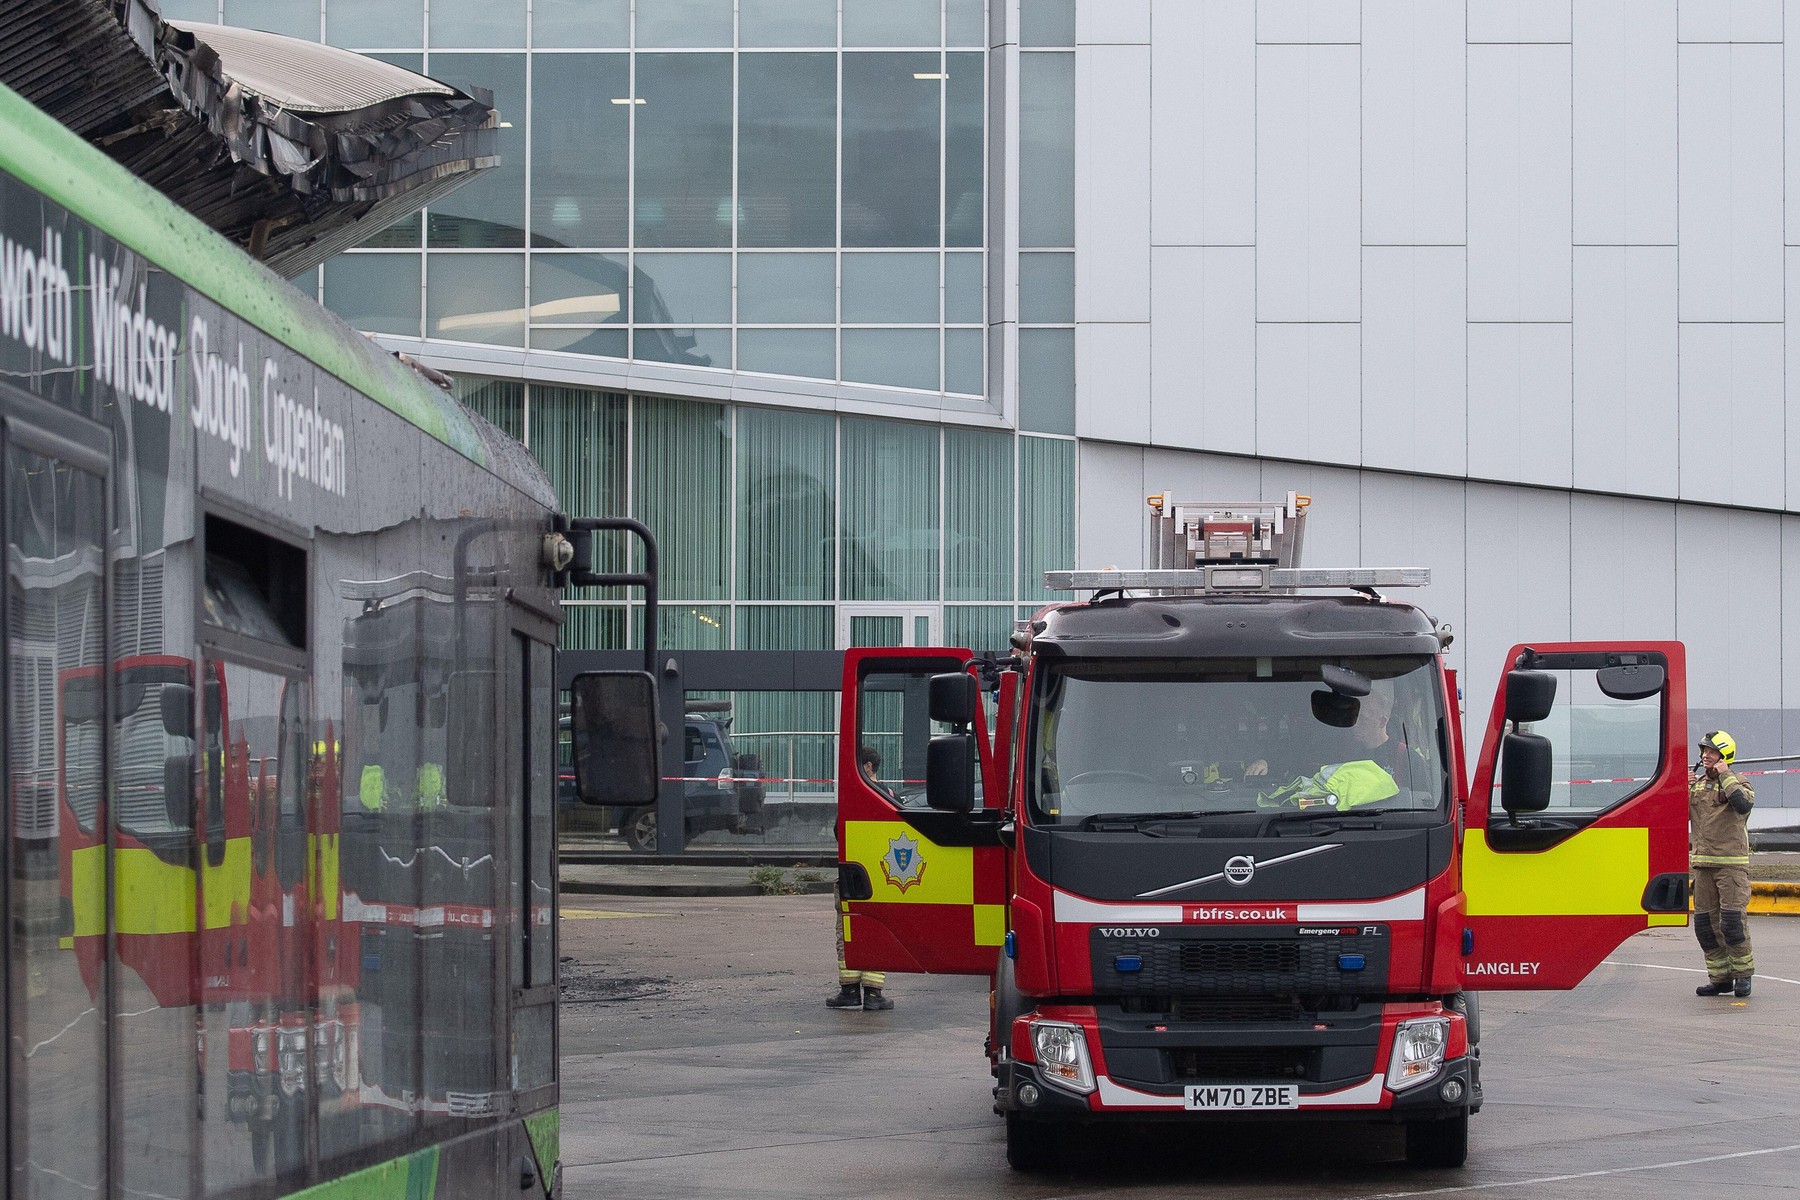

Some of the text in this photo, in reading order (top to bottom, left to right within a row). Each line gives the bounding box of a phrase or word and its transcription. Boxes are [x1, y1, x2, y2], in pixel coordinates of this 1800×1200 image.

[89, 252, 178, 415] Windsor
[191, 314, 251, 478] Slough
[263, 358, 346, 501] Cippenham
[1192, 907, 1287, 920] rbfrs.co.uk
[1099, 927, 1160, 938] VOLVO
[1362, 926, 1382, 936] FL
[1466, 962, 1540, 975] LANGLEY
[1193, 1087, 1290, 1107] KM70 ZBE
